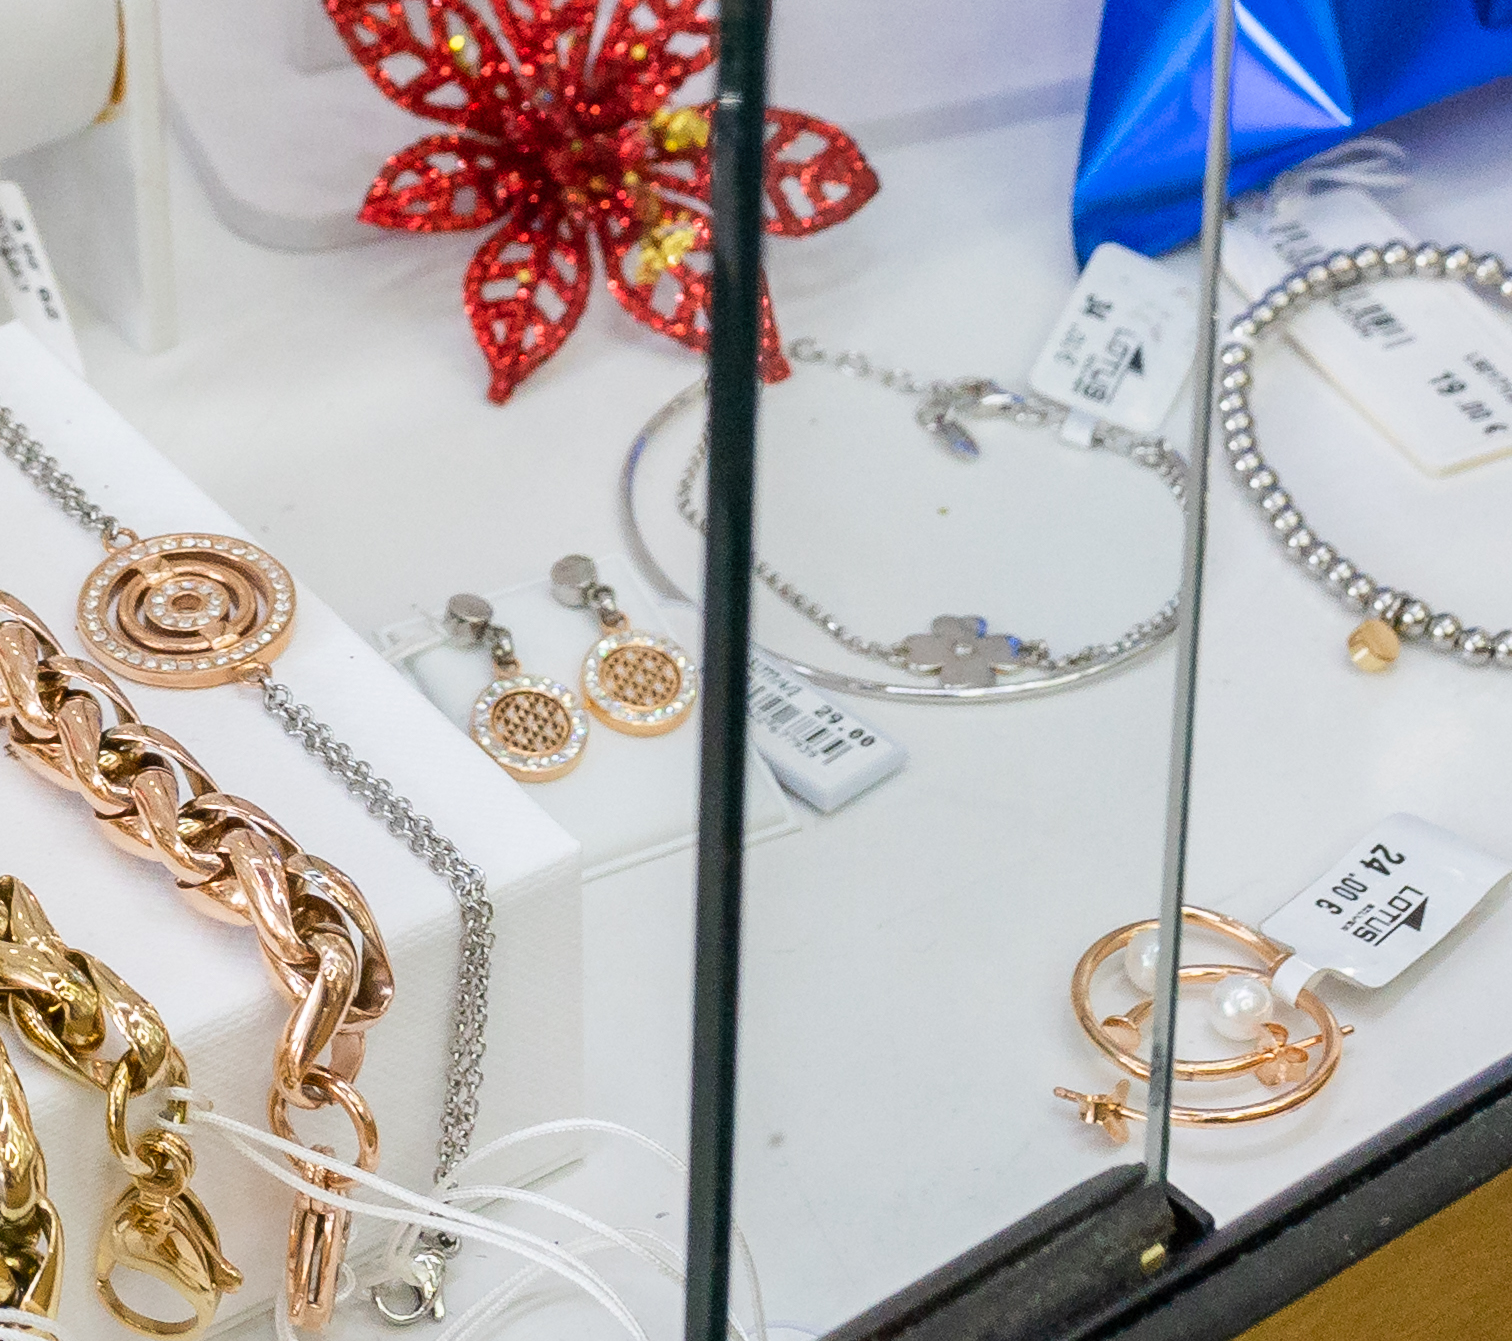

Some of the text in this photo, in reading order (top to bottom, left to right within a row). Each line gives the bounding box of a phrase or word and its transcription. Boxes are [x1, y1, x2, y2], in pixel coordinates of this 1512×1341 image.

[813, 703, 875, 748] 29.00
[1314, 843, 1406, 916] 24 .00 €
[1352, 885, 1425, 944] LOTUS
